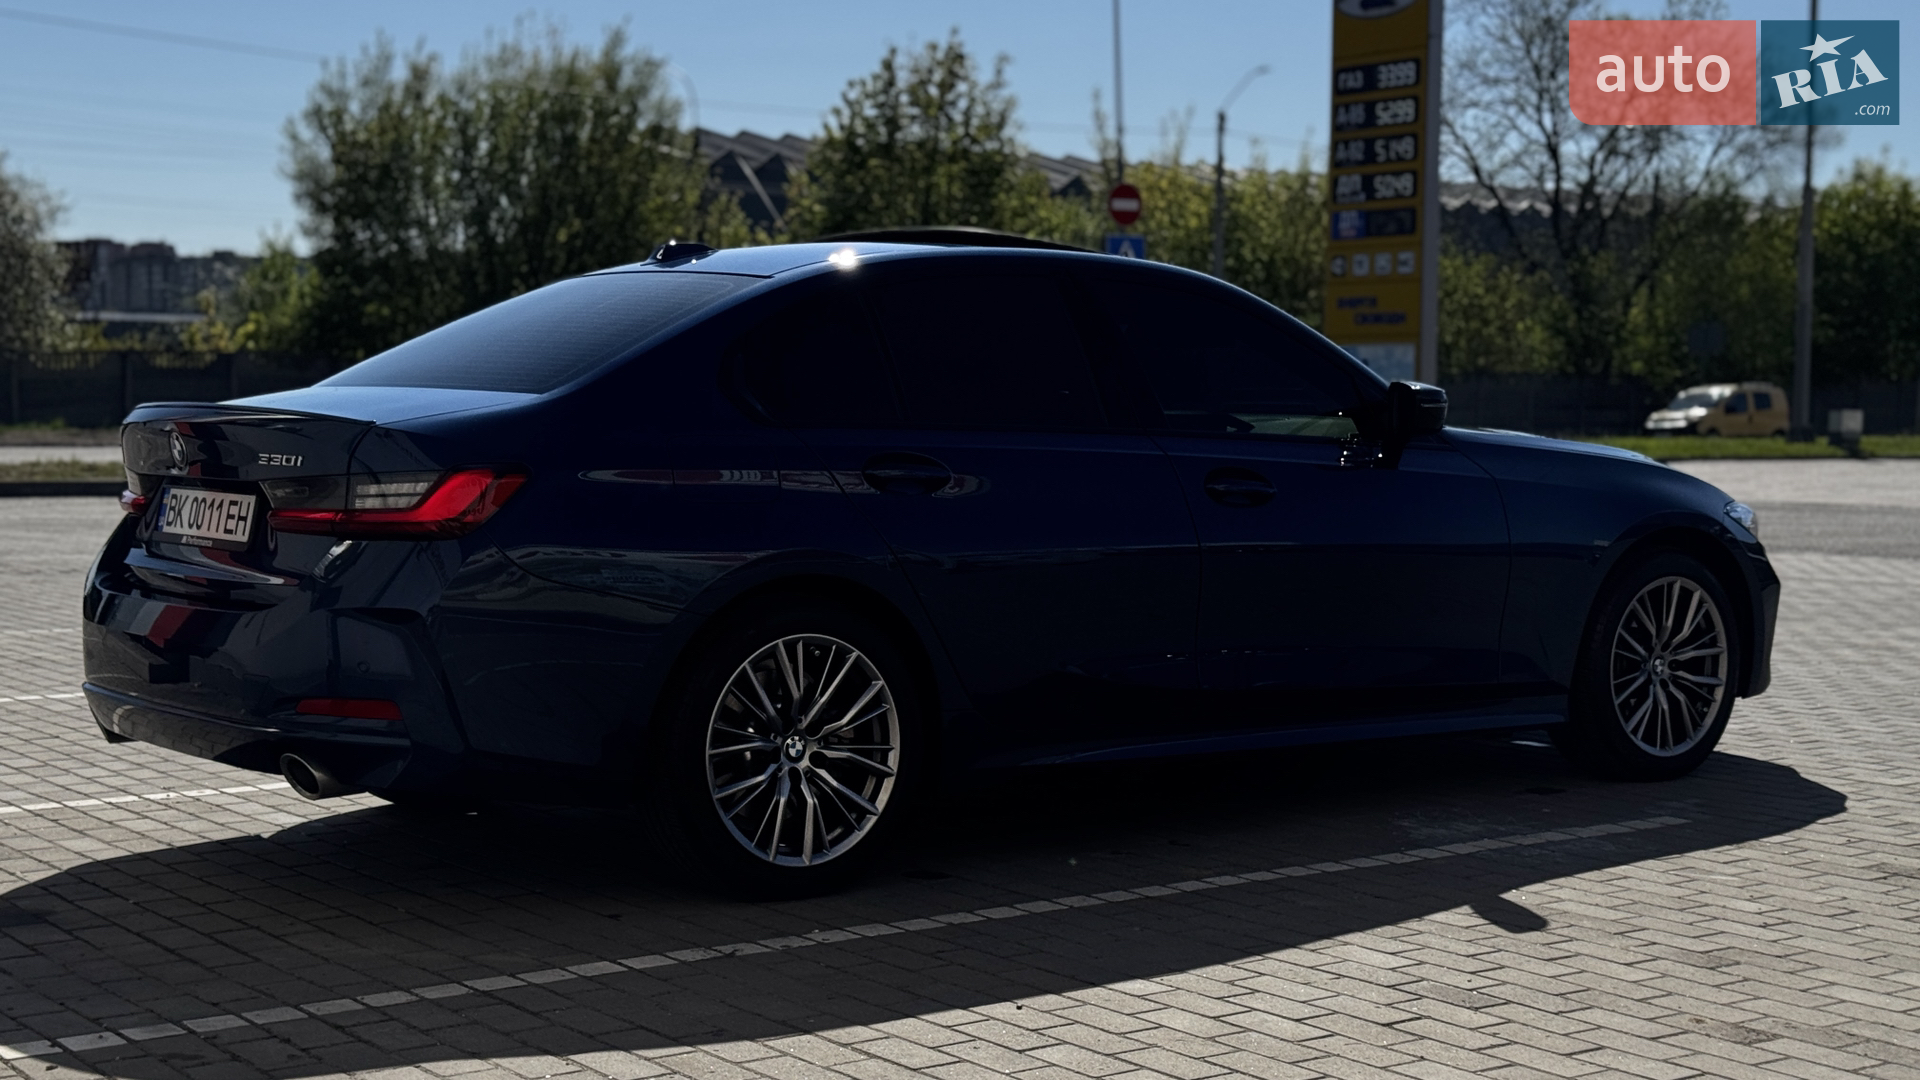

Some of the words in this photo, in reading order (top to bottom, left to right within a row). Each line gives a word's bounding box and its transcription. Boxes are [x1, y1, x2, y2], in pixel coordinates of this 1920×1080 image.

[165, 493, 190, 529] BK
[187, 496, 225, 533] 0011
[223, 499, 251, 536] EH
